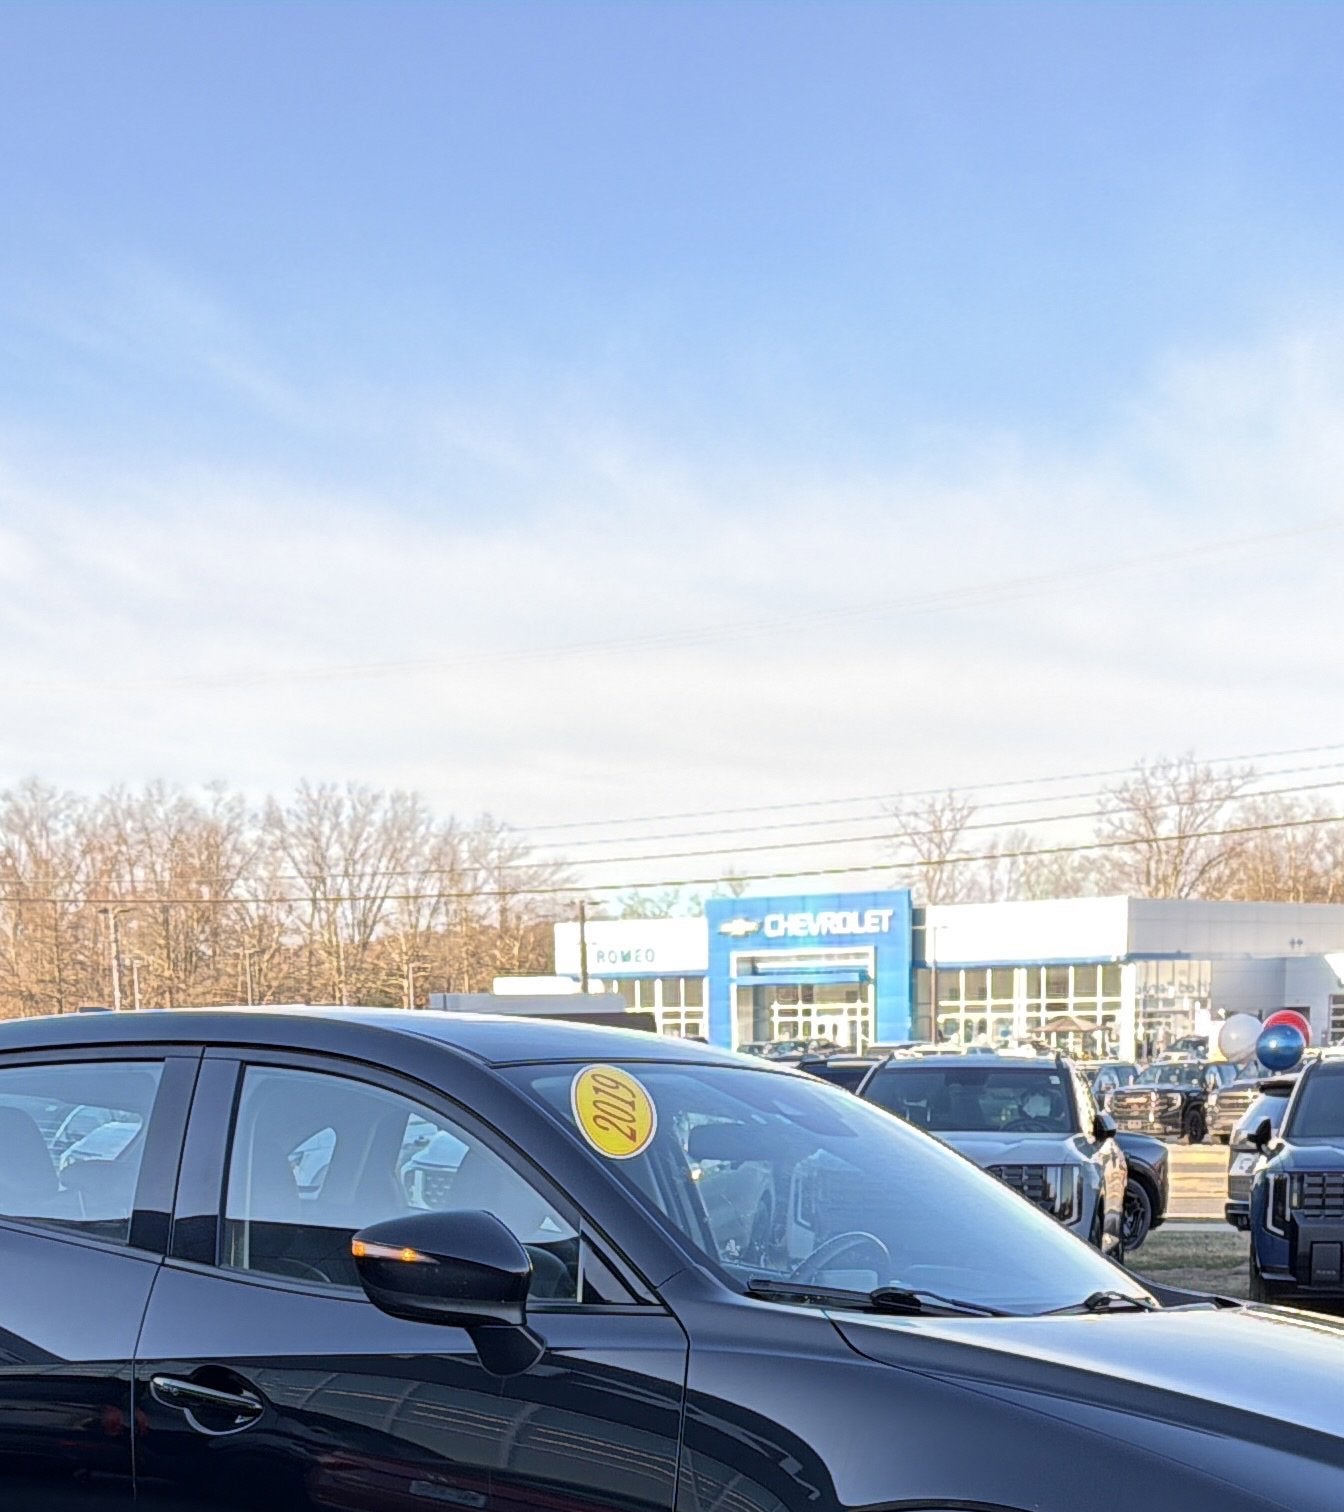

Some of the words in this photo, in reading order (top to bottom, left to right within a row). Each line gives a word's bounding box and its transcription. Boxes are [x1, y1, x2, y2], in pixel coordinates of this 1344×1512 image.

[763, 909, 894, 938] CHEVROLET
[596, 948, 655, 964] ROMEO
[590, 1073, 637, 1143] 2019
